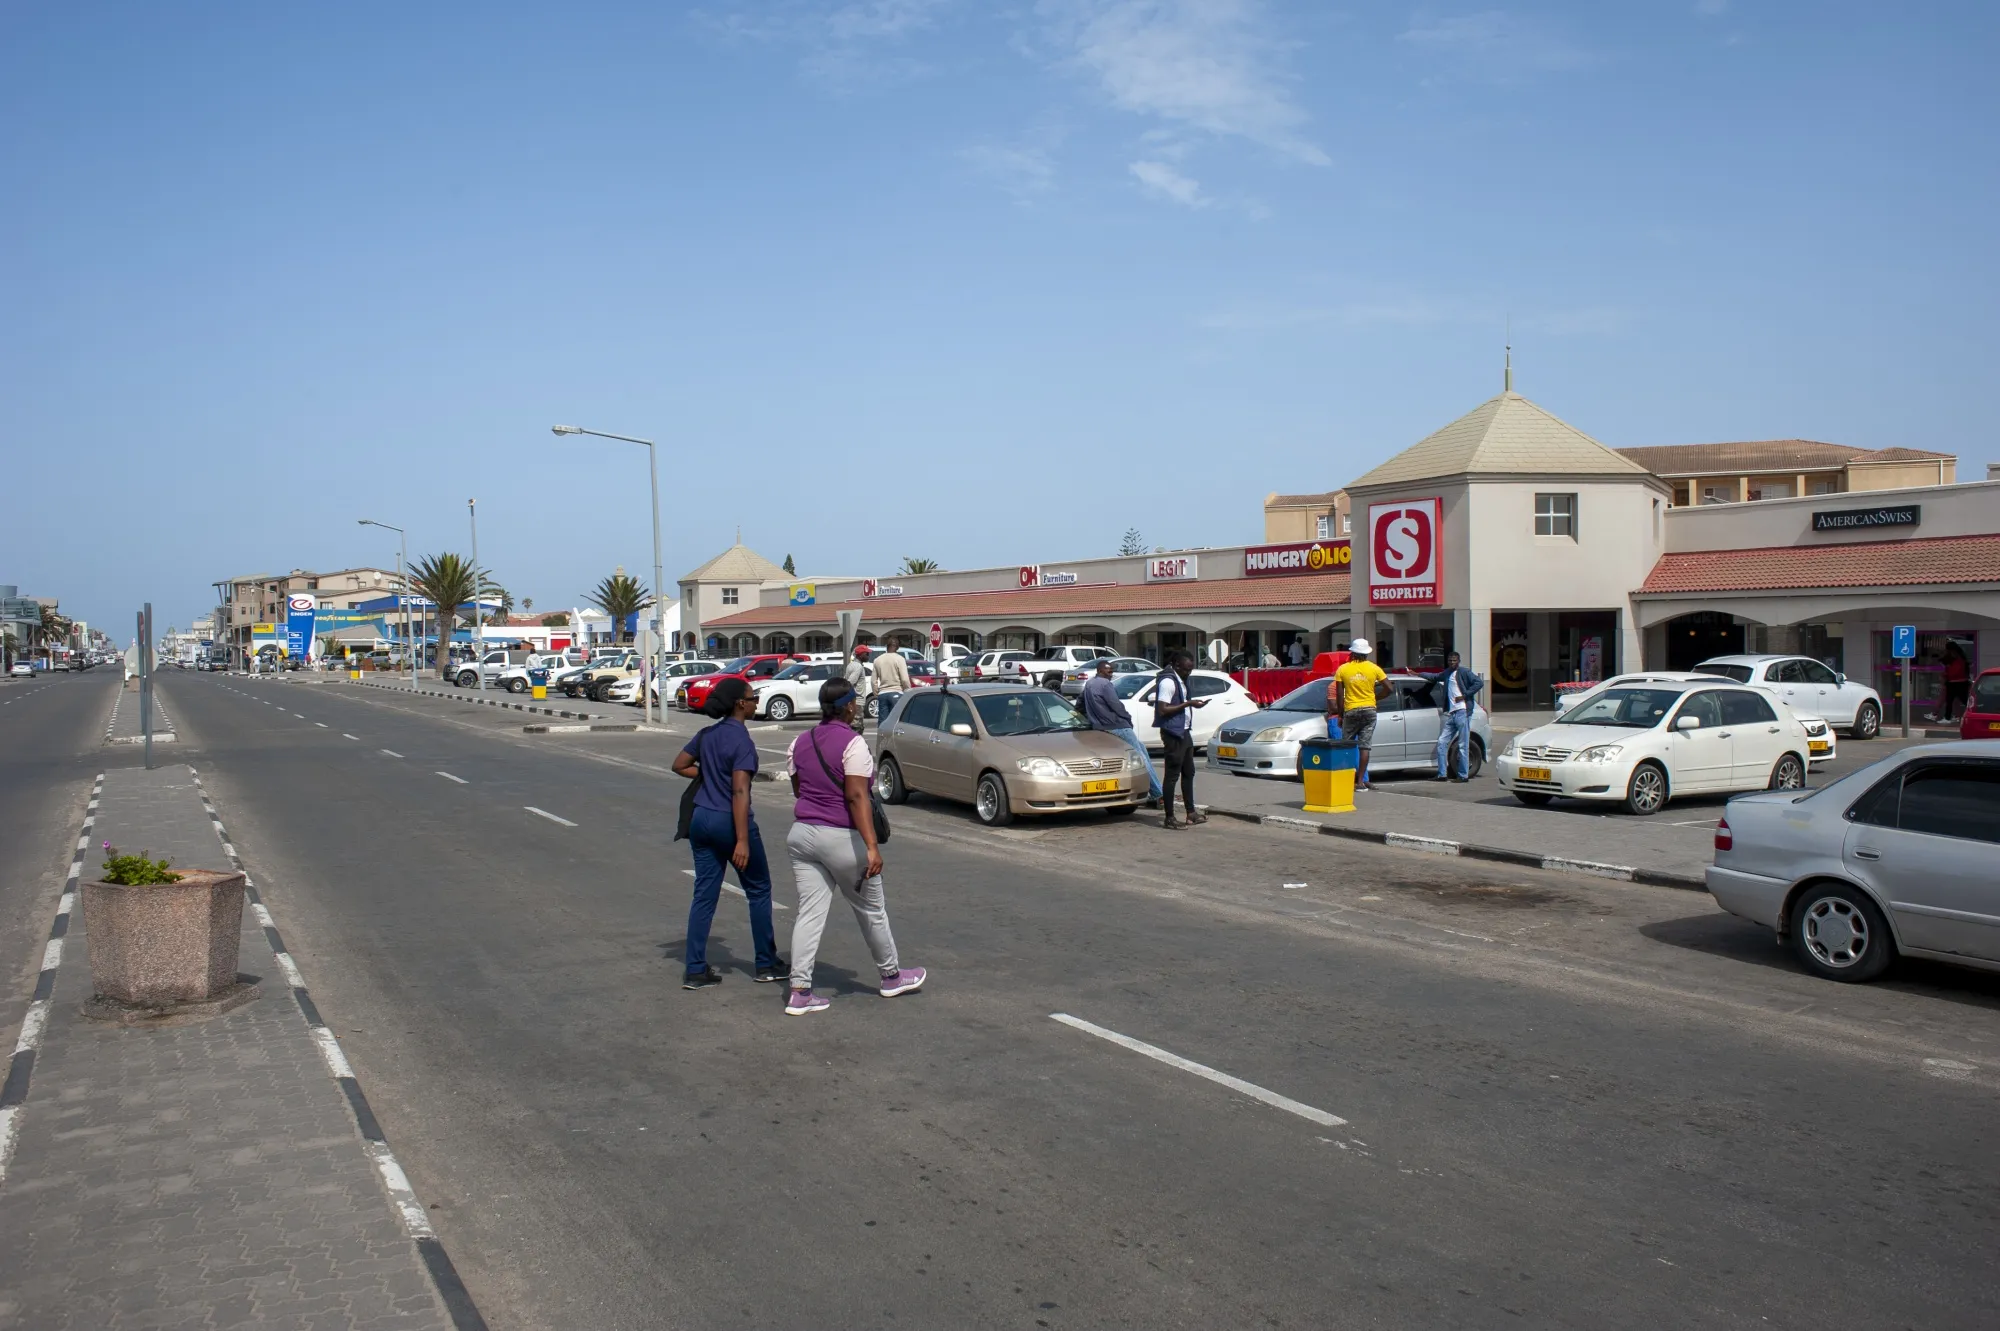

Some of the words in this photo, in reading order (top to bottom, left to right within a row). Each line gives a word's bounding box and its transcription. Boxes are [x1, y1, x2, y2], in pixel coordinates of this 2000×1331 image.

[1246, 549, 1310, 570] HUNGRY
[1325, 545, 1351, 565] LIO
[1019, 565, 1041, 587] OK
[1043, 571, 1077, 585] Furniture
[863, 578, 877, 597] OK
[879, 585, 903, 596] Furniture
[1372, 586, 1434, 600] SHOPRITE
[400, 597, 437, 605] ENGE
[796, 590, 809, 600] PEP
[931, 631, 941, 641] STOP
[1899, 628, 1910, 640] P
[1096, 782, 1107, 791] 400
